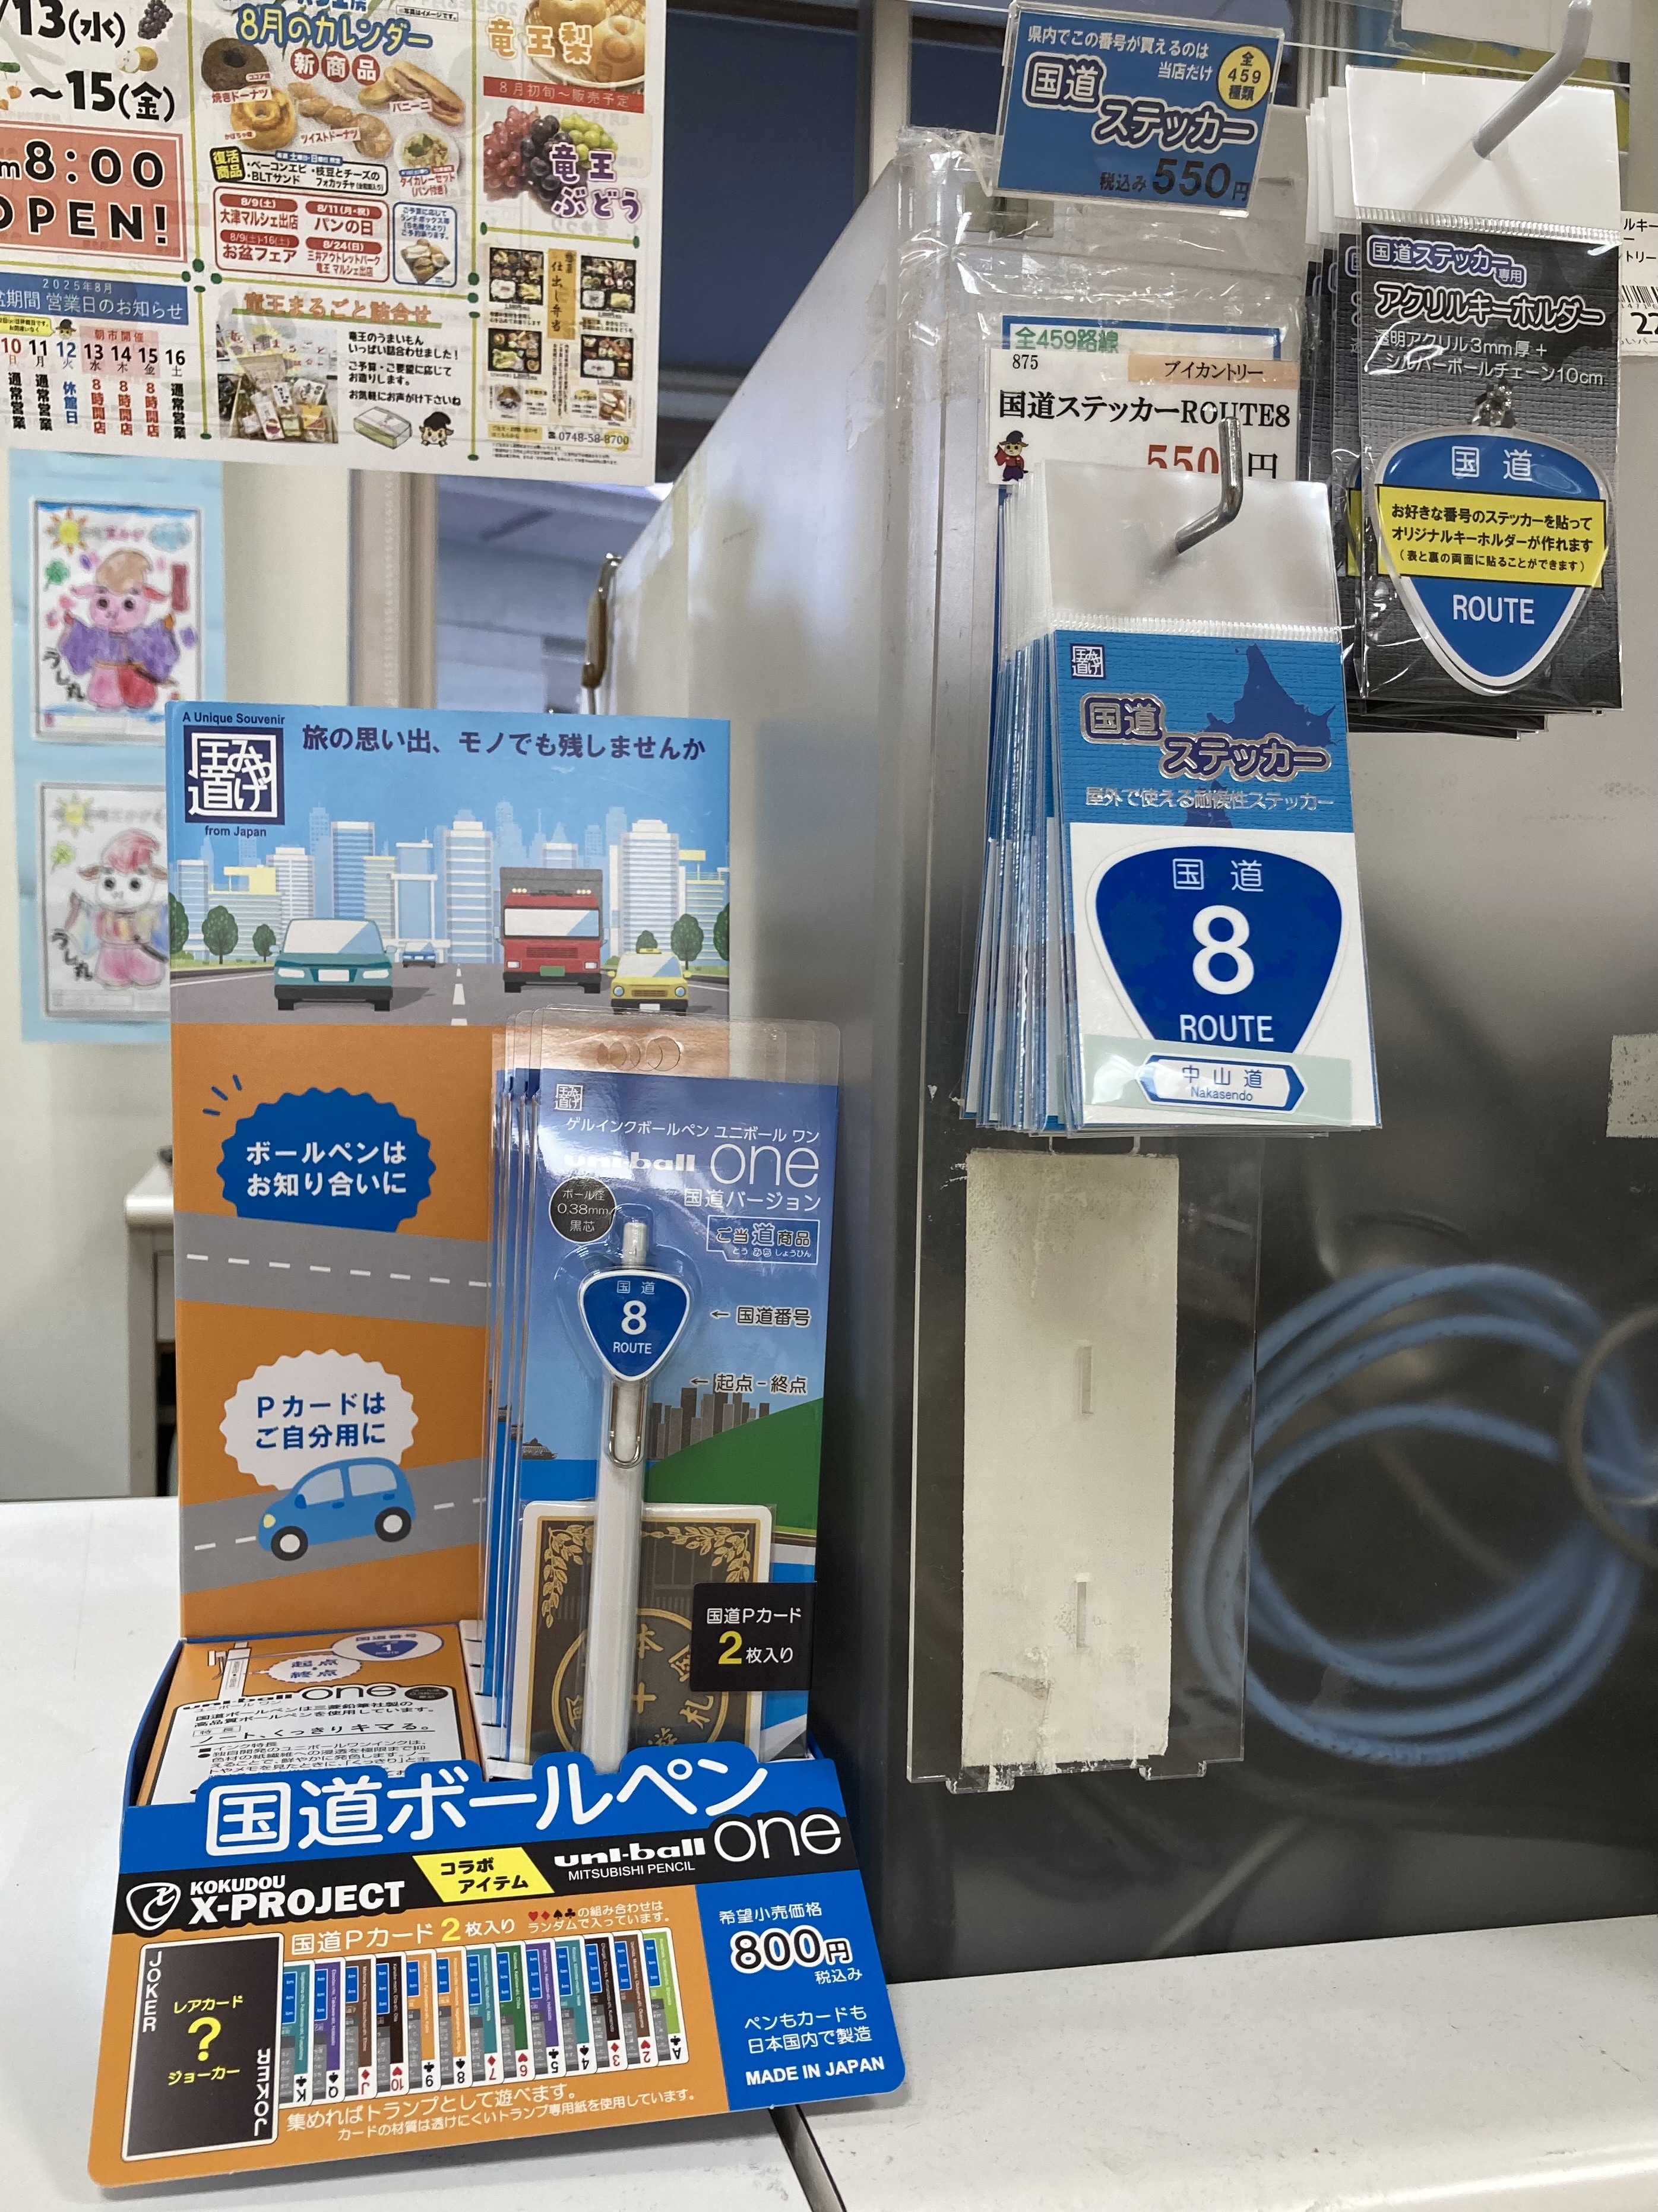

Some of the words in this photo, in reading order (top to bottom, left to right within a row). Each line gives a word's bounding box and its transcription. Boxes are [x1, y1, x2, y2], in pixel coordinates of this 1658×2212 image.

[239, 6, 432, 53] 8月のカレンダー
[488, 17, 593, 65] 竜王梨
[1027, 26, 1210, 58] 県内でこの番号が買えるのは
[294, 52, 377, 82] 新商品
[1241, 51, 1254, 66] 全
[1026, 56, 1103, 107] 国道
[1158, 61, 1213, 82] 当店だけ
[1227, 68, 1261, 84] 459
[1229, 84, 1255, 102] 種類
[1096, 98, 1255, 150] ステッカー
[300, 129, 359, 144] ツイストドーナツ
[551, 144, 616, 184] 竜王
[1099, 172, 1147, 192] 税込み
[1152, 158, 1251, 202] 550円
[240, 198, 276, 208] 8/9(土)
[552, 187, 642, 223] ぶどう
[220, 208, 298, 230] 大津マルシェ出店
[314, 217, 374, 236] パンの日
[222, 244, 298, 263] お盆フェア
[322, 240, 365, 252] 8/24(日)
[1369, 239, 1512, 274] 国道ステッカー
[1497, 268, 1523, 284] 専用
[42, 277, 113, 294] 2025年8月
[550, 261, 564, 332] 仕出し弁当
[46, 292, 183, 320] 営業日のお知らせ
[243, 291, 431, 324] 竜王まるごと詰合せ
[1375, 285, 1605, 331] アクリルキーホルダー
[94, 329, 144, 343] 朝市開催
[1, 337, 21, 354] 10
[29, 339, 48, 356] 11
[56, 341, 77, 358] 12
[84, 343, 104, 360] 13
[111, 346, 132, 362] 14
[138, 347, 159, 364] 15
[165, 349, 186, 366] 16
[1012, 354, 1039, 370] 875
[90, 360, 102, 372] 水
[116, 363, 128, 373] 木
[144, 363, 156, 375] 金
[171, 365, 183, 377] 土
[1164, 359, 1264, 381] ブイカントリー
[999, 389, 1291, 428] 国道ステッカーROUTE8
[558, 430, 629, 446] 0748-58-8700
[1451, 446, 1533, 481] 国道
[1391, 503, 1593, 531] お好きな番号のステッカーを貼って
[1391, 527, 1593, 553] オリジナルキーホルダーが作れます
[1453, 594, 1535, 625] ROUTE
[182, 712, 191, 723] A
[194, 712, 233, 725] Unique
[236, 714, 286, 725] Souvenir
[1085, 697, 1163, 740] 国道
[1162, 735, 1329, 780] ステッカー
[1085, 786, 1334, 812] 屋外で使える耐候性ステッカー
[205, 825, 230, 836] from
[233, 826, 267, 838] Japan
[1172, 857, 1264, 893] 国道
[1191, 904, 1255, 995] 8
[1179, 1014, 1274, 1042] ROUTE
[1182, 1065, 1263, 1089] 中山道
[1190, 1085, 1254, 1102] Nakasendo
[566, 1116, 710, 1138] ゲルインクボールペン
[714, 1126, 787, 1142] ユニボール
[792, 1129, 819, 1144] ワン
[246, 1140, 407, 1166] ボールペンは
[710, 1143, 819, 1188] one
[246, 1171, 407, 1197] お知り合いに
[562, 1189, 606, 1202] ボール径
[557, 1202, 610, 1216] 0.38mm
[684, 1189, 821, 1212] 国道バージョン
[569, 1219, 596, 1234] 黒芯
[716, 1222, 811, 1247] ご当道商品
[732, 1248, 748, 1256] とう
[752, 1247, 772, 1257] みち
[775, 1248, 812, 1258] しょうひん
[616, 1281, 655, 1295] 国道
[621, 1300, 647, 1336] 8
[736, 1307, 812, 1328] 国道番号
[612, 1341, 653, 1355] ROUTE
[257, 1392, 386, 1419] Pカードは
[256, 1422, 386, 1450] ご自分用に
[706, 1607, 801, 1625] 国道Pカード
[718, 1631, 793, 1665] 2枚入り
[301, 1685, 397, 1700] one
[199, 1722, 429, 1744] ノート、くっきりキマる。
[205, 1758, 768, 1856] 国道ボールペン
[553, 1837, 706, 1868] uni-ball
[714, 1812, 842, 1863] one
[441, 1858, 494, 1876] コラボ
[568, 1864, 645, 1881] MITSUBISHI
[648, 1860, 696, 1874] PENCIL
[190, 1875, 286, 1896] KOKUDOU
[458, 1874, 529, 1894] アイテム
[188, 1881, 406, 1925] X-PROJECT
[578, 1900, 663, 1918] の組み合わせは
[719, 1902, 822, 1925] 希望小売価格
[527, 1912, 670, 1934] ランダムで入っています。
[291, 1923, 434, 1956] 国道Pカード
[441, 1917, 515, 1942] 2枚入り
[732, 1926, 852, 1972] 800円
[814, 1967, 863, 1984] 税込み
[142, 1950, 163, 2033] JOKER
[173, 1995, 243, 2014] レアカード
[744, 2005, 867, 2030] ペンもカードも
[188, 2016, 222, 2062] ?
[748, 2025, 873, 2054] 日本国内で製造
[581, 2057, 590, 2070] 4
[612, 2054, 621, 2067] 3
[643, 2051, 651, 2063] 2
[672, 2048, 682, 2059] A
[168, 2067, 241, 2086] ジョーカー
[457, 2071, 466, 2084] 8
[489, 2068, 497, 2080] 7
[550, 2061, 559, 2074] 5
[745, 2066, 799, 2086] MADE
[802, 2062, 821, 2080] IN
[825, 2055, 885, 2077] JAPAN
[254, 2048, 271, 2137] JOKER
[296, 2089, 306, 2102] K
[328, 2086, 339, 2099] Q
[361, 2082, 370, 2095] J
[391, 2078, 404, 2091] 10
[287, 2083, 577, 2132] 集めればトランプとして遊べます。
[337, 2088, 695, 2142] カードの材質は透けにくいトランプ専用紙を使用しています。
